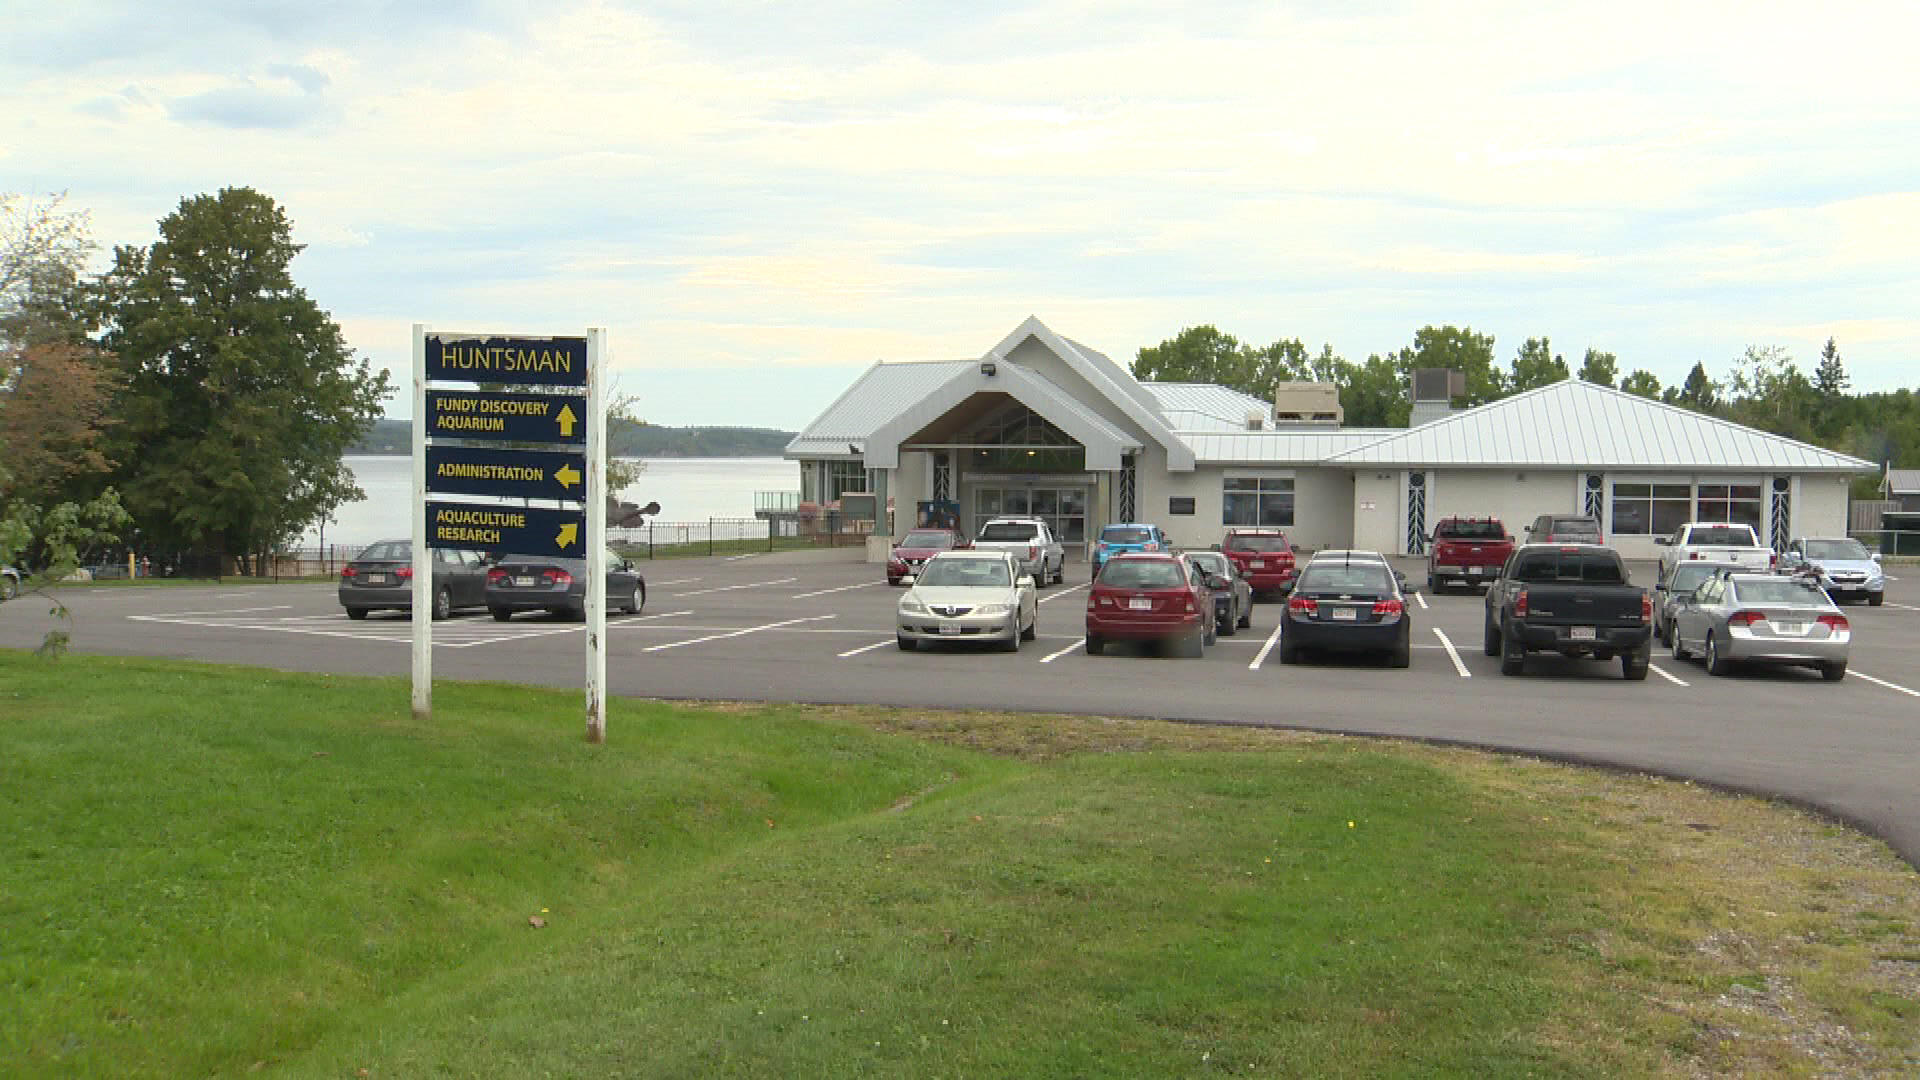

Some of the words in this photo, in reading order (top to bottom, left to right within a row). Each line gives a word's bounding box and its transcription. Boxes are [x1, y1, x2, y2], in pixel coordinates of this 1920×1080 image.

[442, 347, 570, 373] HUNTSMAN
[436, 398, 478, 412] FUNDY
[480, 400, 549, 415] DISCOVERY
[437, 415, 504, 431] AQUARIUM
[437, 463, 544, 480] ADMINISTRATION
[436, 509, 525, 528] AQUACULTURE
[437, 527, 500, 543] RESEARCH
